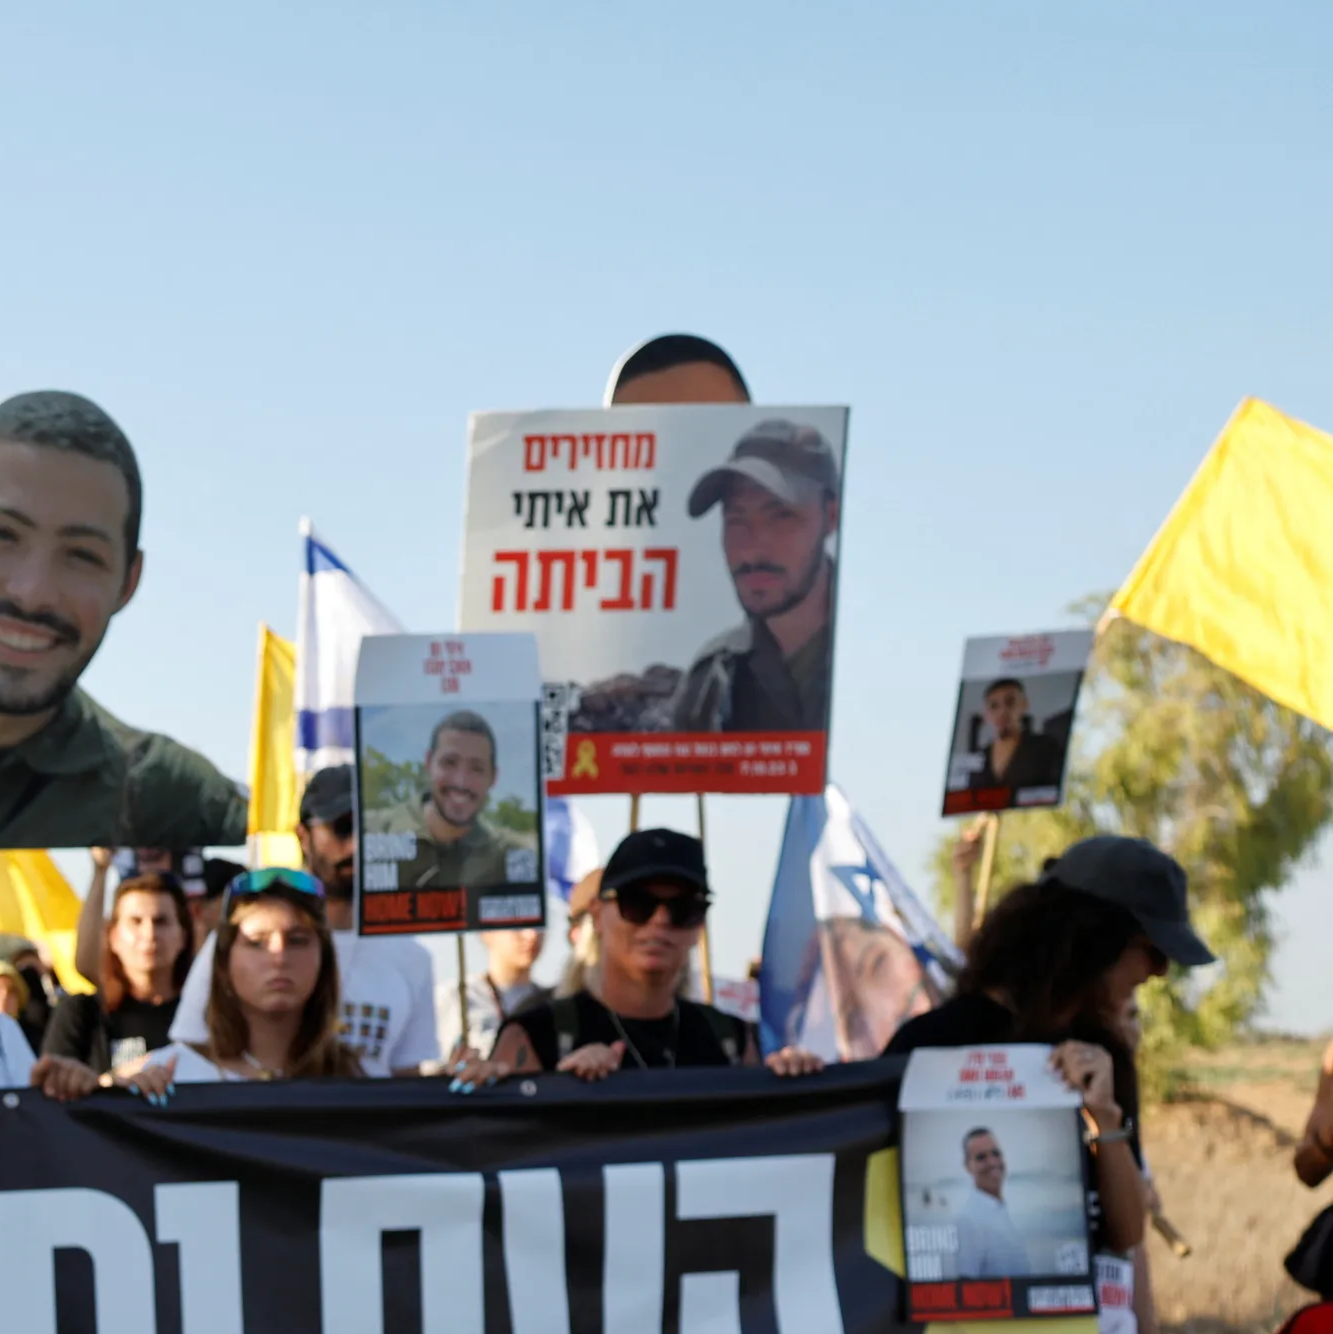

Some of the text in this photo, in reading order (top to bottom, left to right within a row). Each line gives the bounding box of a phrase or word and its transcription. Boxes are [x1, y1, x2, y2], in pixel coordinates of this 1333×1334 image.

[523, 432, 656, 471] מחזירים
[513, 488, 660, 528] את איתי
[491, 548, 679, 612] הביתה
[364, 862, 399, 891] HIM
